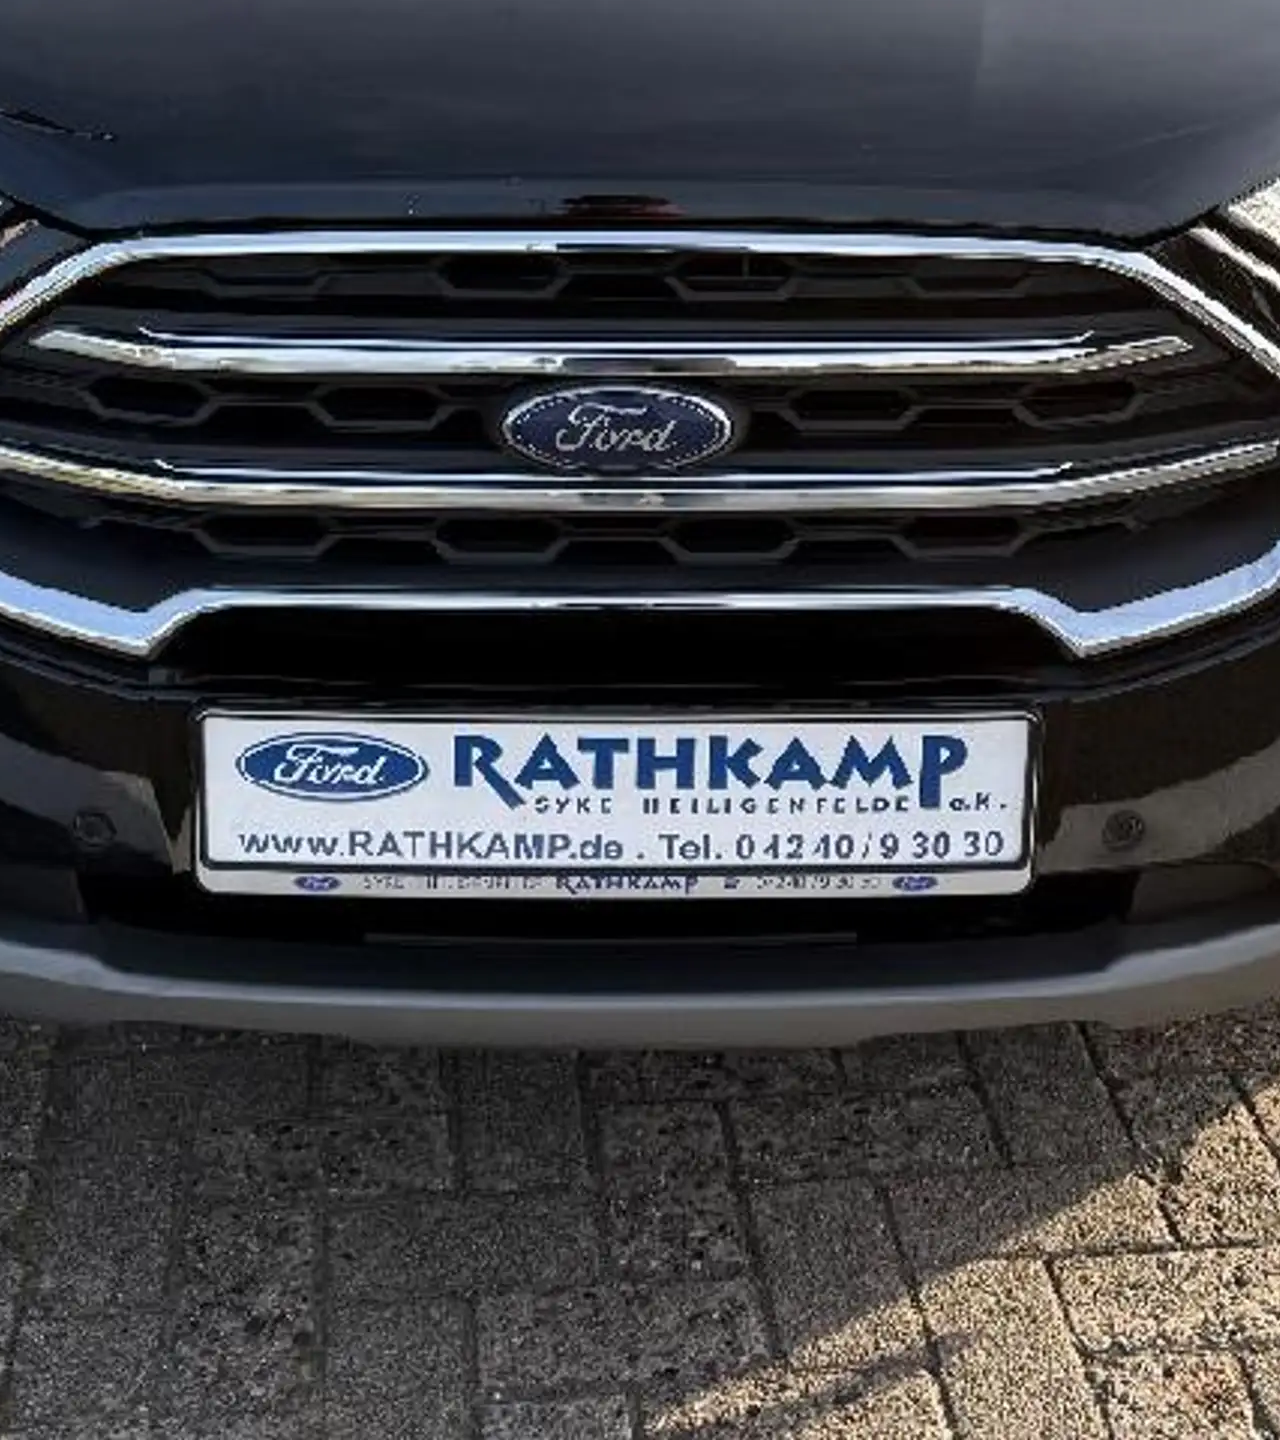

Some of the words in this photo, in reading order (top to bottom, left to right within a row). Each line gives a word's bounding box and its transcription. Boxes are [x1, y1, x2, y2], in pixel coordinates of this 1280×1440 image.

[555, 402, 676, 452] Ford
[273, 743, 386, 786] Ford
[453, 732, 969, 811] RATHKAMP
[642, 795, 910, 814] HEILIGENFELDE
[238, 830, 624, 861] www.RATHKAMP.de
[658, 832, 723, 861] Tel.
